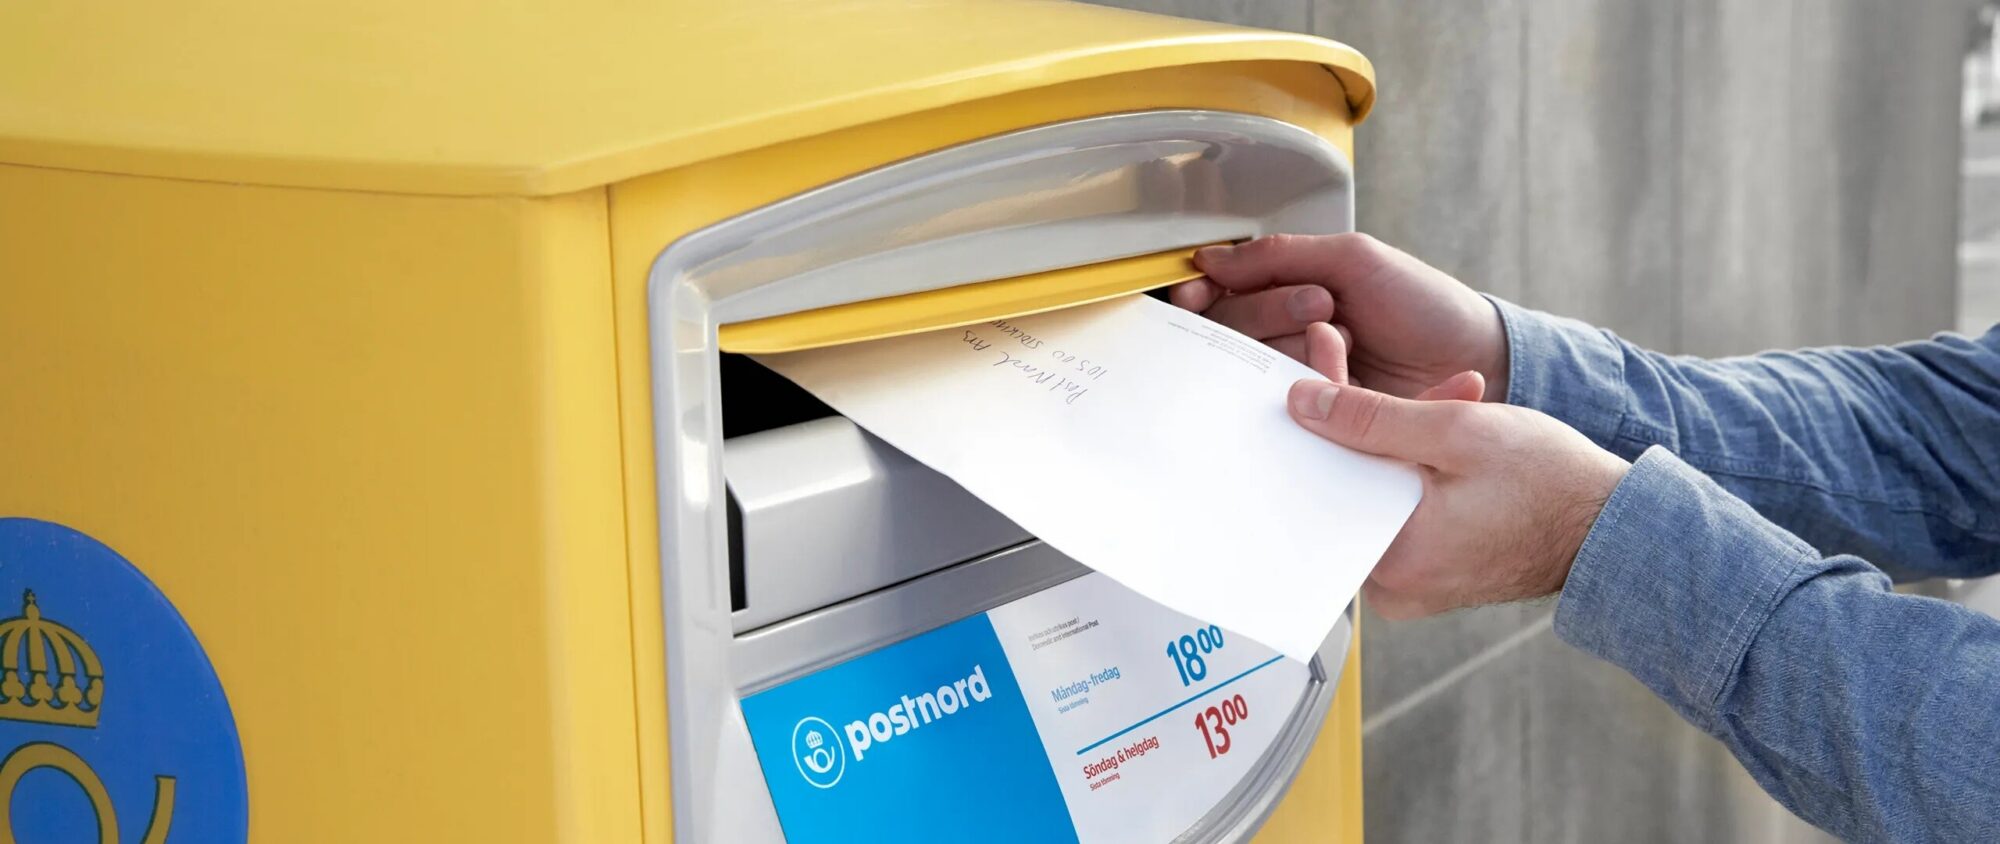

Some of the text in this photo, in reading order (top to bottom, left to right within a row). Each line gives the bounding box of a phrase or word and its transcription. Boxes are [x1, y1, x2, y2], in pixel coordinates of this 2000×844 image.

[1051, 666, 1121, 702] Måndag-fredag
[844, 664, 992, 761] postnord
[1083, 736, 1160, 779] Söndag & helgdag
